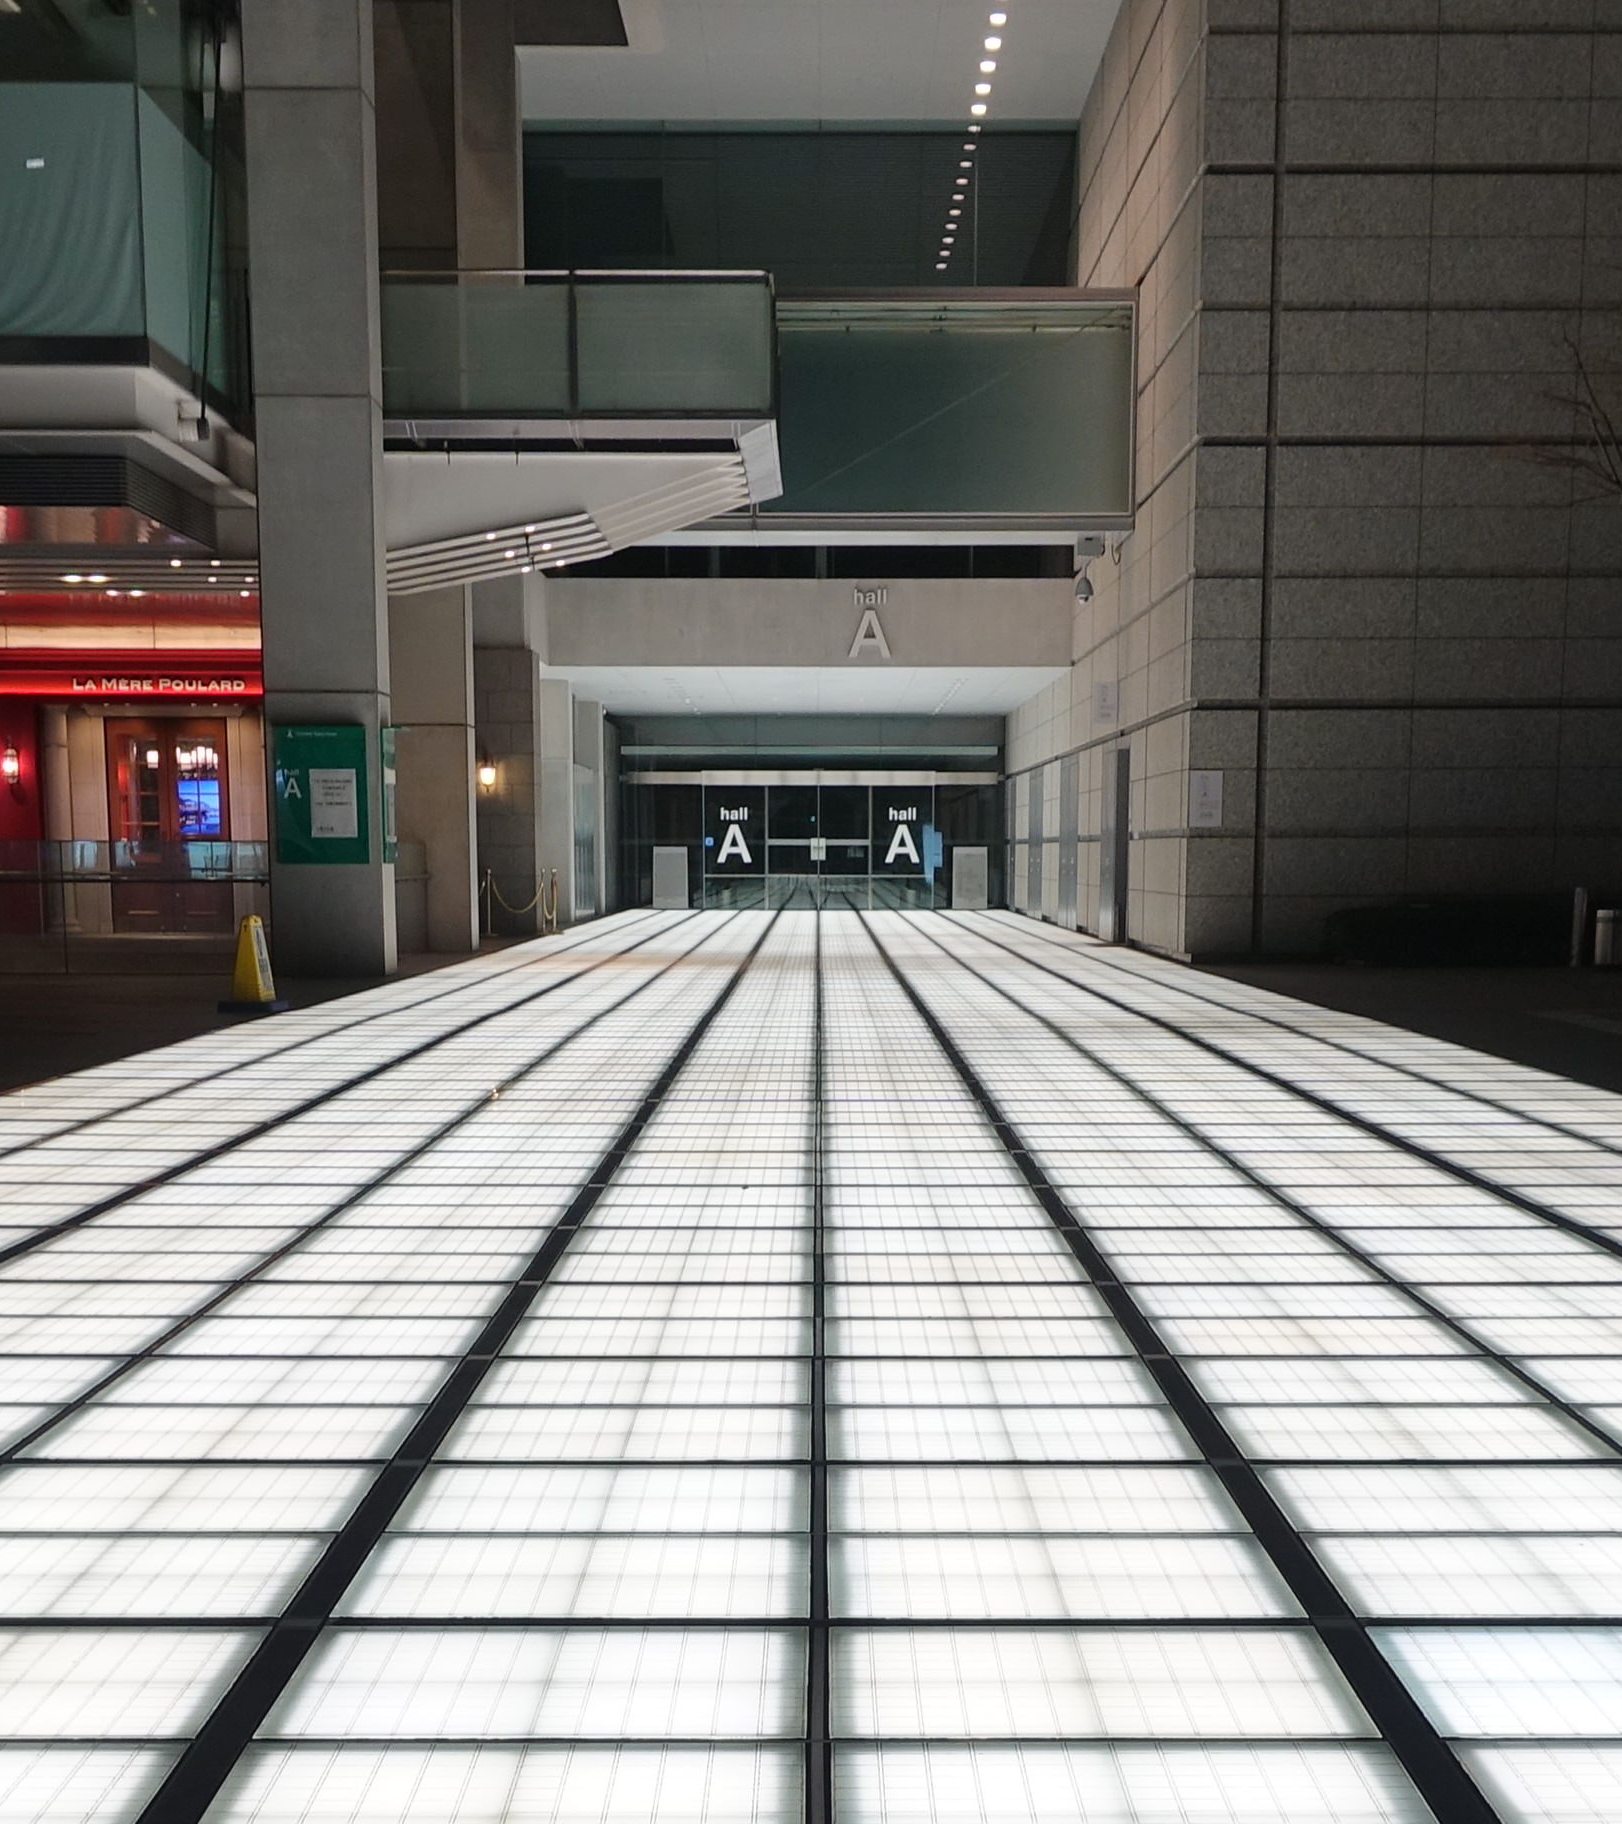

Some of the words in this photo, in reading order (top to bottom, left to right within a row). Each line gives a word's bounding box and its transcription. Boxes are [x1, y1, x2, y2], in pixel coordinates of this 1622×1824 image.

[854, 588, 887, 605] hall
[848, 609, 892, 658] A
[72, 677, 97, 690] LA
[159, 678, 245, 691] POULARD
[284, 778, 302, 799] A
[720, 806, 748, 821] hall
[889, 806, 917, 821] hall
[717, 823, 752, 864] A
[884, 823, 920, 864] A
